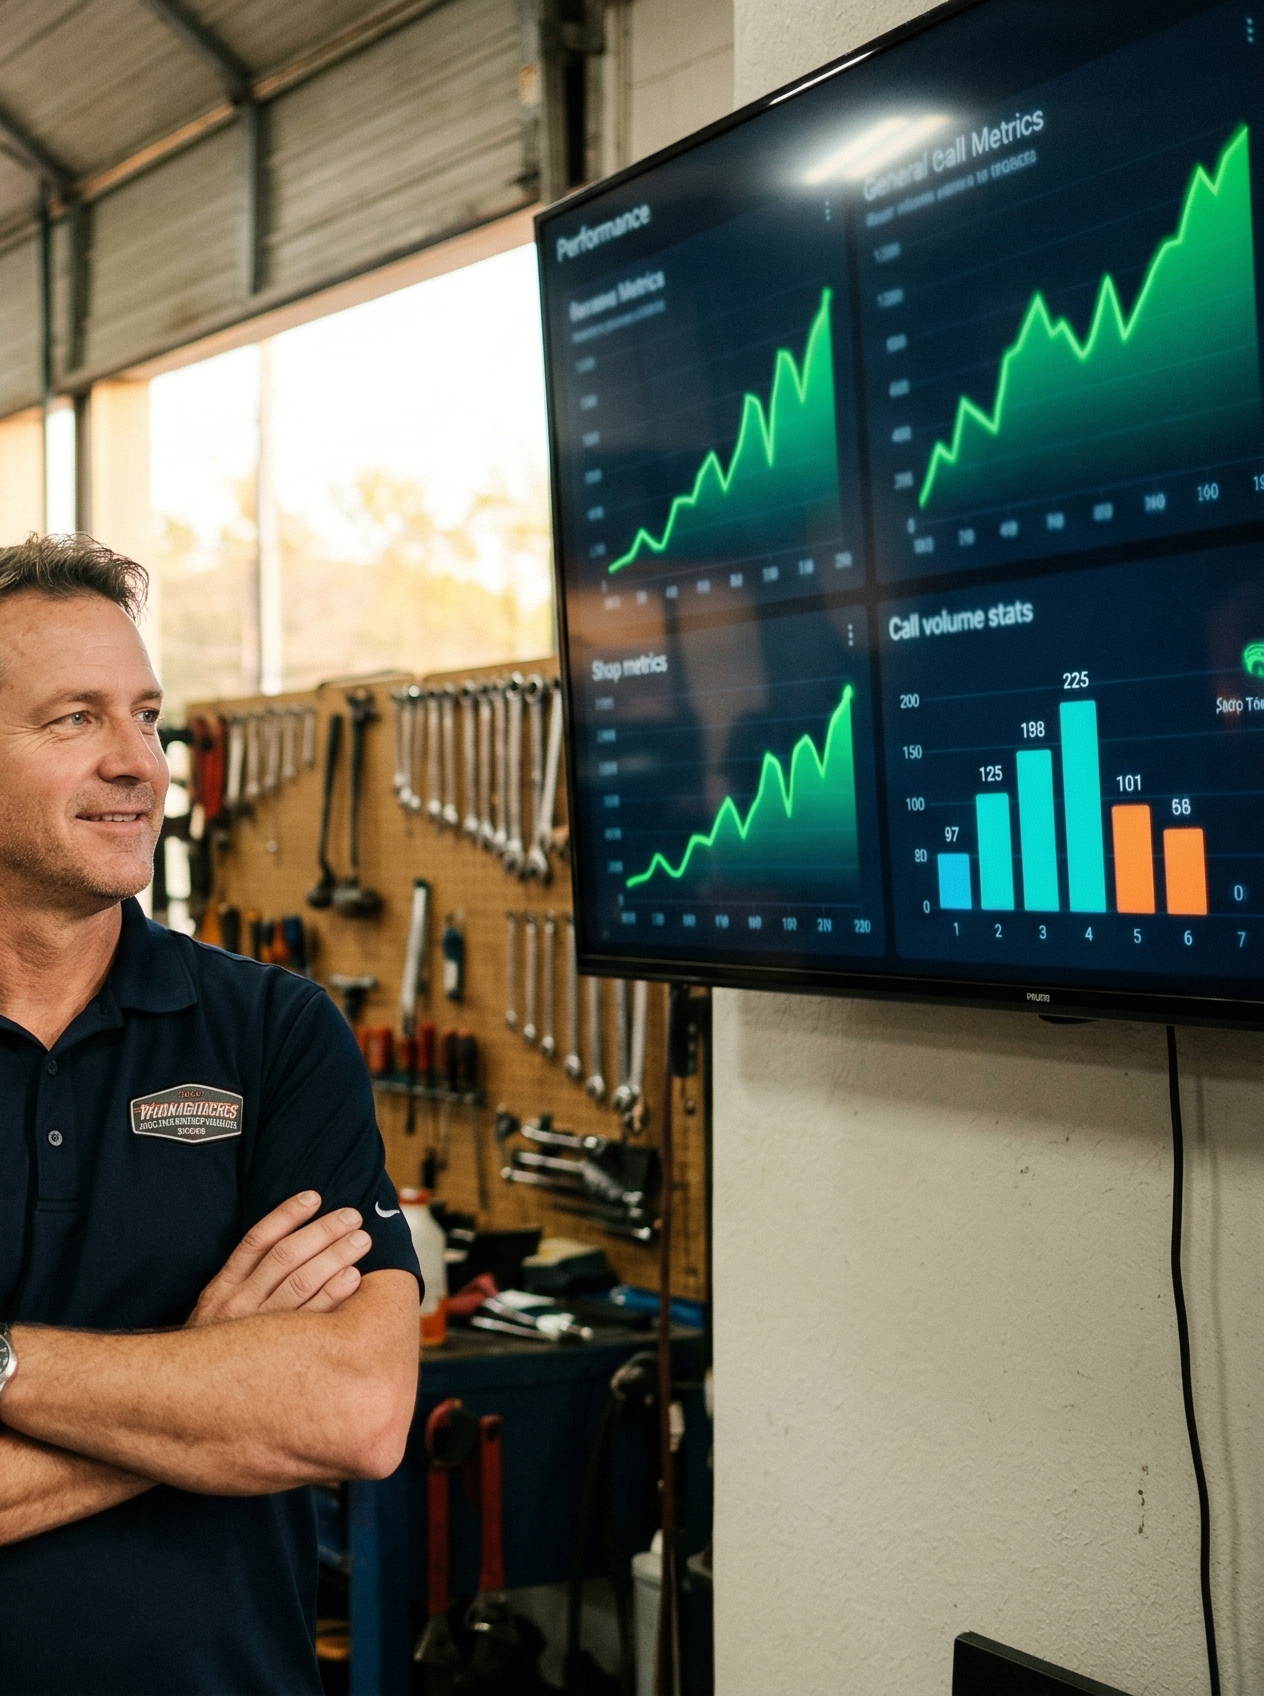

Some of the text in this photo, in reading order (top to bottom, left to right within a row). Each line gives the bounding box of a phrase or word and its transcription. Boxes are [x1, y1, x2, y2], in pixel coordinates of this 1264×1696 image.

[932, 134, 966, 172] Call
[971, 110, 1044, 157] Metrics
[557, 204, 651, 262] Performance
[889, 600, 1034, 641] Call volume stats
[1063, 671, 1089, 690] 225
[900, 693, 920, 709] 200
[1020, 721, 1045, 738] 198
[902, 744, 923, 759] 150
[979, 765, 1003, 782] 125
[1116, 774, 1142, 792] 101
[906, 797, 925, 811] 100
[944, 826, 959, 842] 97
[923, 900, 931, 914] 0
[953, 922, 1246, 947] 1 2 3 4 5 6 7
